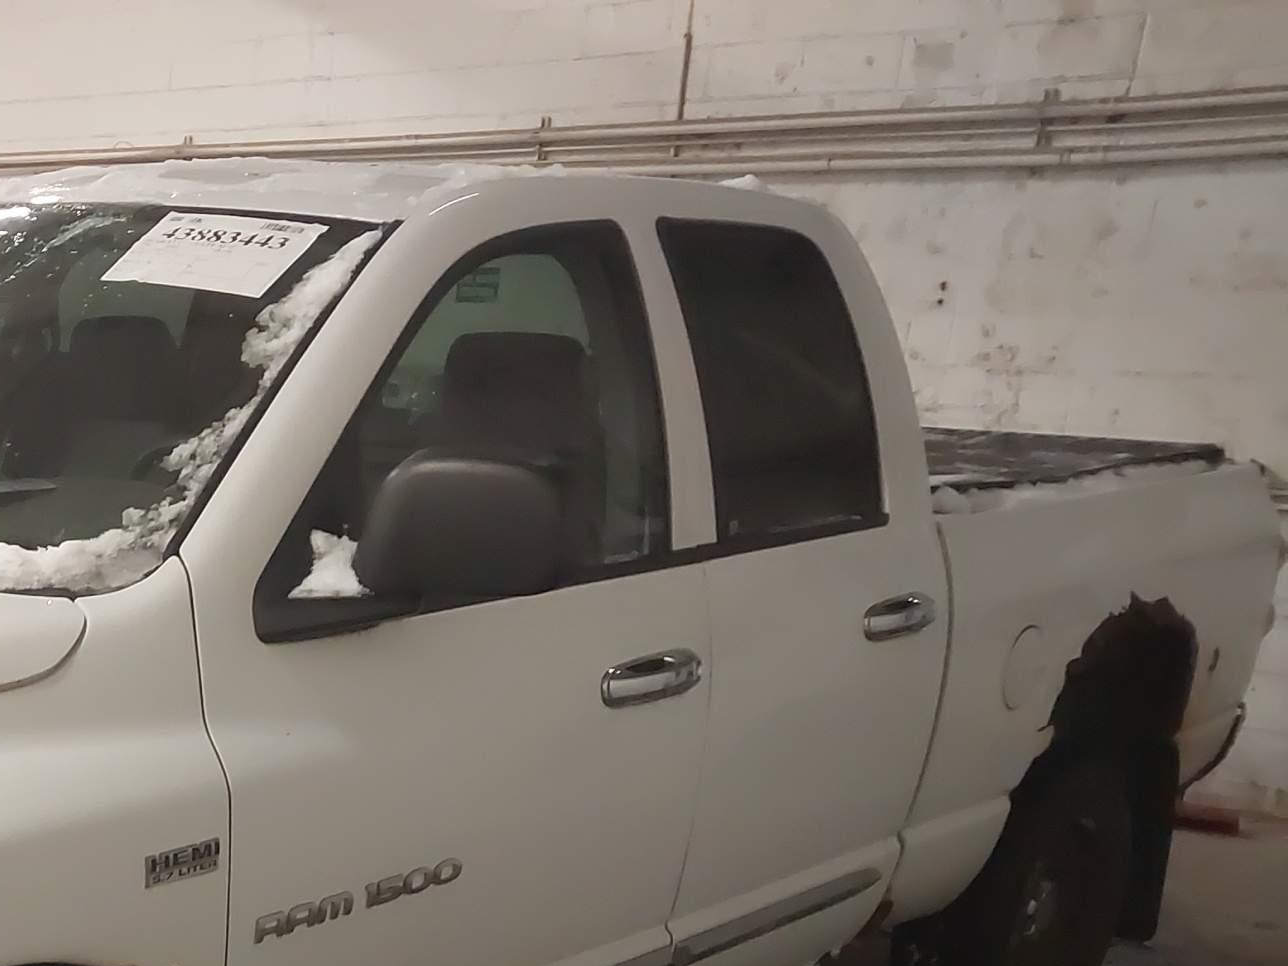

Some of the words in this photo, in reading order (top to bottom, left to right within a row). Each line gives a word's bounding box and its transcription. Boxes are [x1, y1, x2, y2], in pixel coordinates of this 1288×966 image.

[162, 227, 290, 249] 43883443
[150, 840, 221, 873] HEMI
[178, 859, 217, 877] LITER
[253, 890, 355, 945] RAM
[364, 857, 463, 909] 1500
